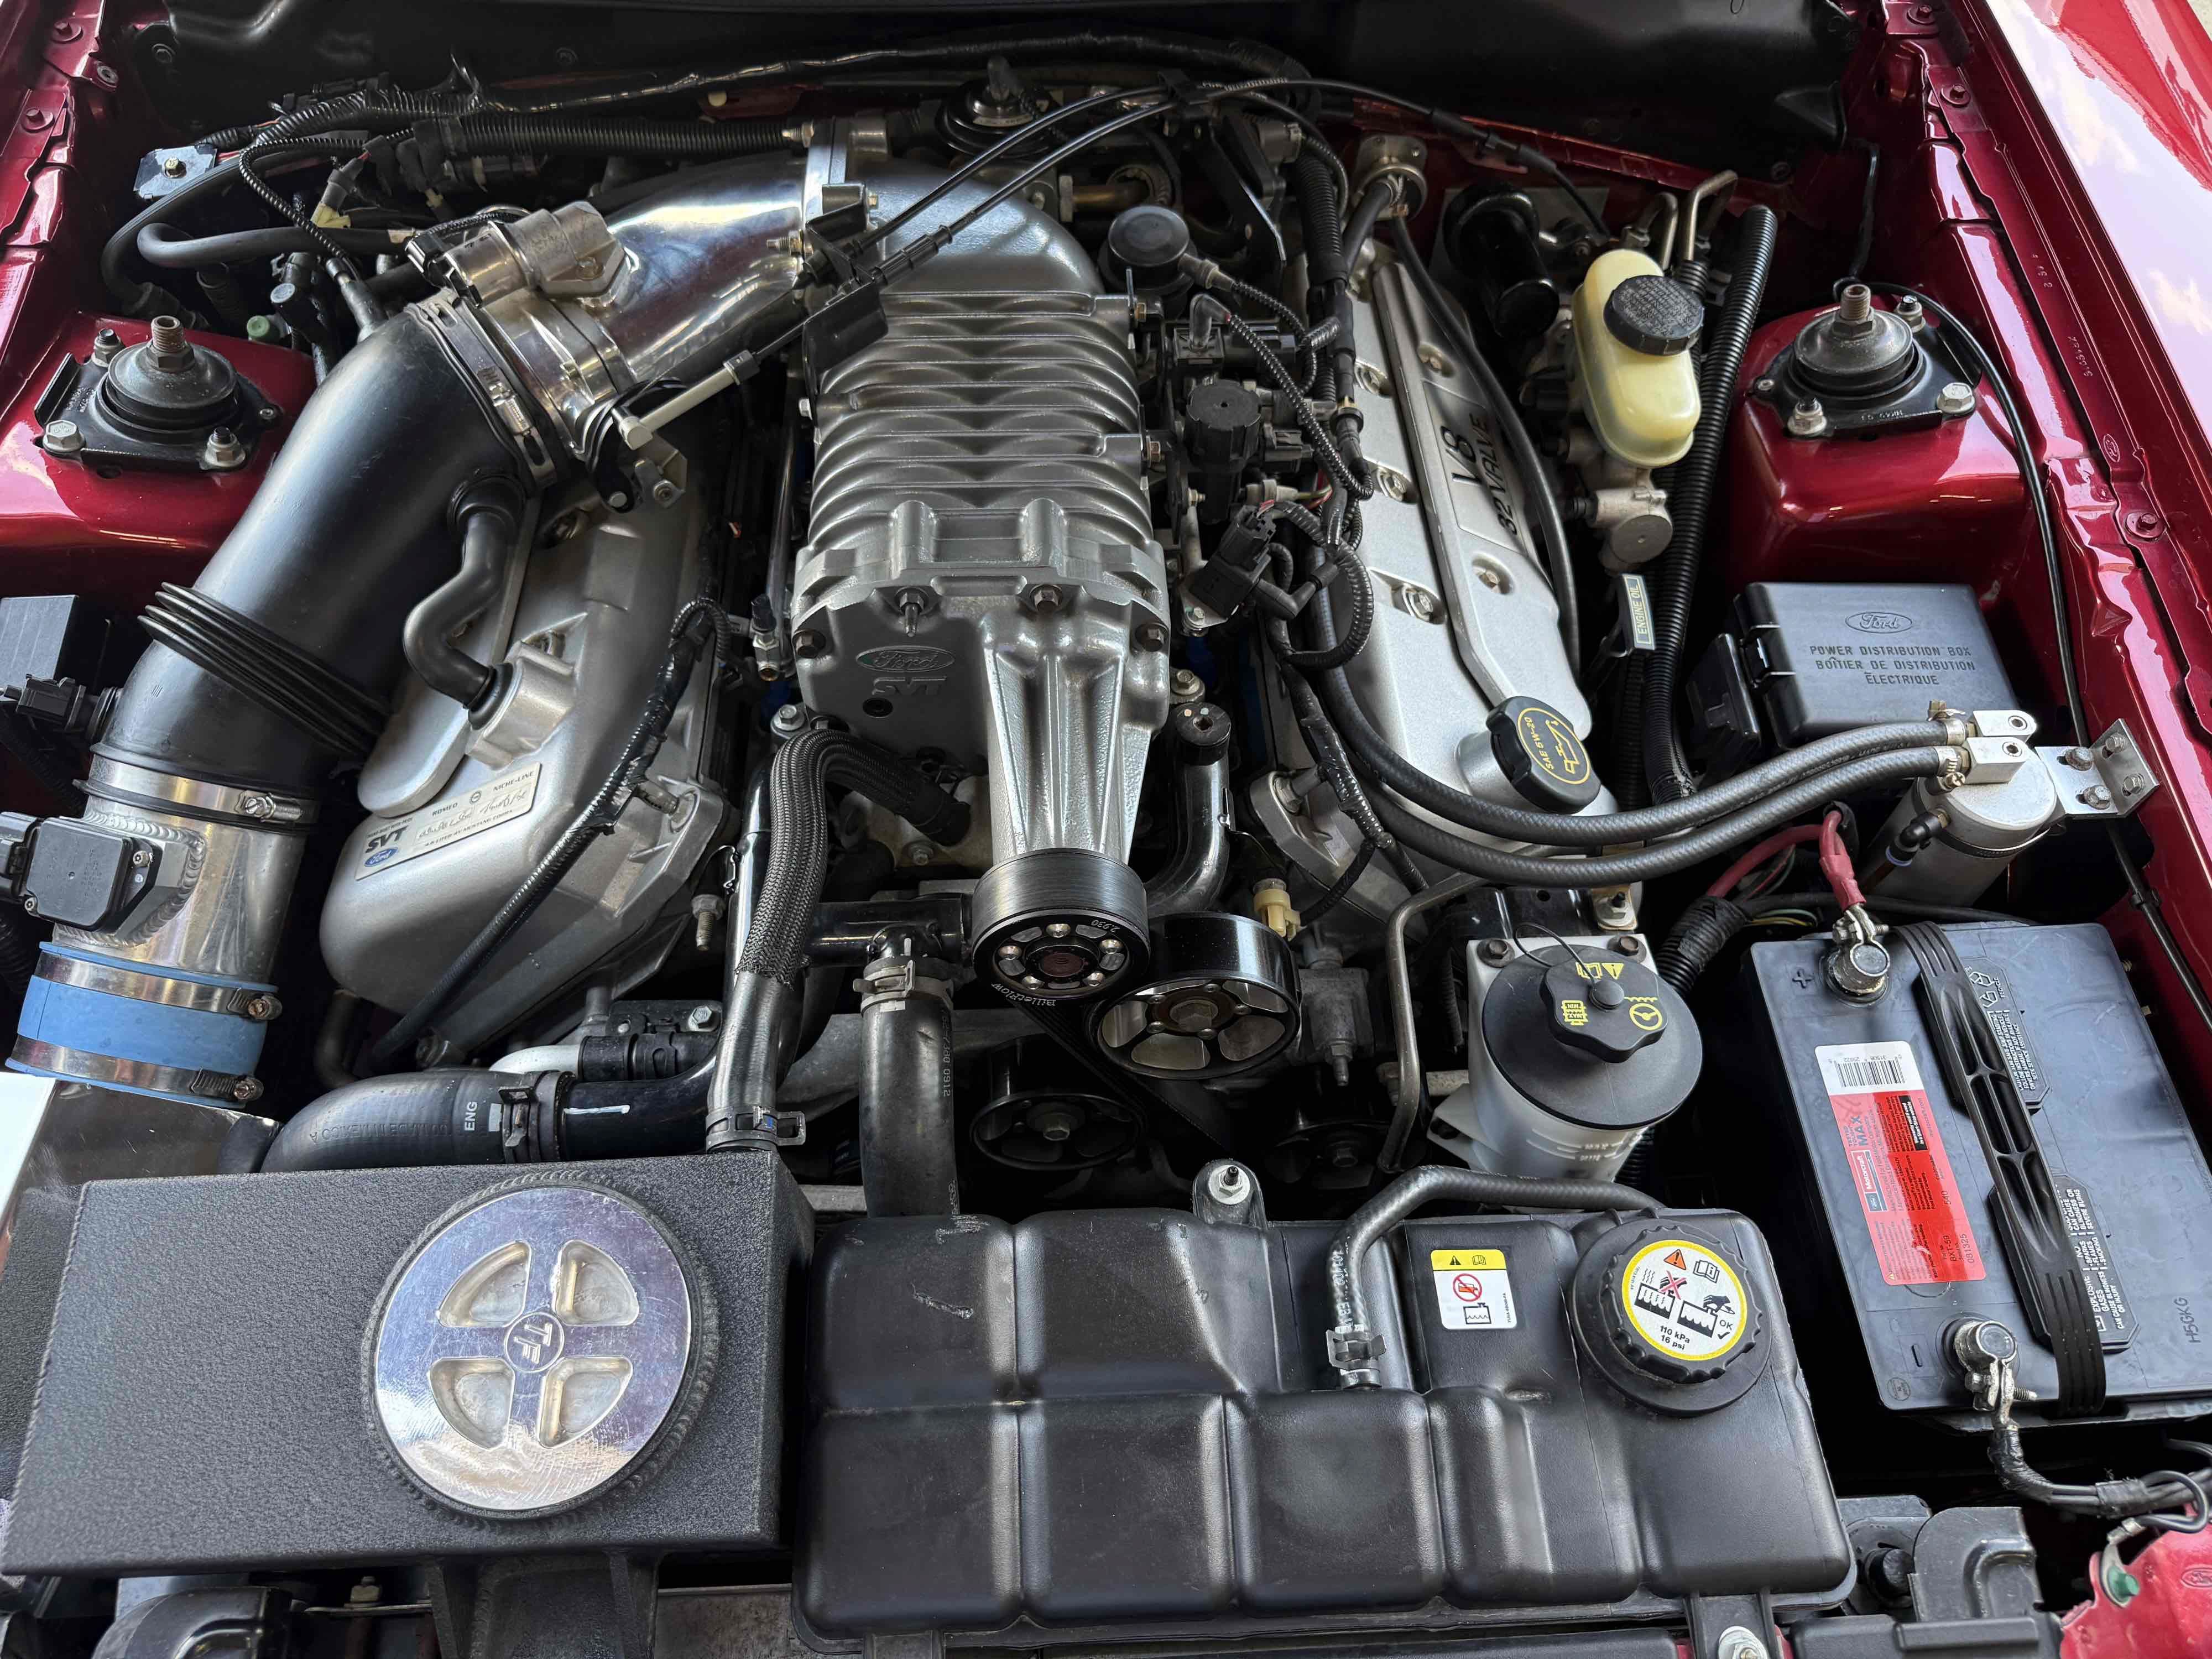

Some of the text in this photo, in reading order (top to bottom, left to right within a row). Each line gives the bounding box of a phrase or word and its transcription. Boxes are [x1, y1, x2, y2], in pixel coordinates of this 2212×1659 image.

[1441, 425, 1484, 486] V8
[1494, 497, 1517, 535] 32
[1629, 584, 1647, 634] ENGINE OIL
[1859, 613, 1900, 629] Ford
[874, 649, 939, 670] Ford
[1809, 645, 1972, 656] POWER DISTRIBUTION BOX
[1815, 656, 1976, 671] BOÎTIER DE DISTRIBUTION
[872, 675, 948, 696] SVT
[1524, 716, 1554, 771] SAE 5W-20
[365, 825, 409, 853] SVT
[1091, 919, 1121, 933] 2.930
[2006, 1039, 2022, 1070] INSTRUCTIONS
[943, 1068, 952, 1097] 0912
[463, 1100, 478, 1132] ENG
[1906, 1101, 1915, 1115] vehicle
[1850, 1115, 1869, 1146] MAX
[1908, 1124, 1919, 1143] Warranty
[1911, 1115, 1922, 1136] Start-Stop
[1856, 1155, 1872, 1189] Motorcraft
[1940, 1190, 1952, 1204] 540
[2063, 1198, 2073, 1217] CAUSE
[2071, 1199, 2086, 1229] BLINDNESS
[2073, 1189, 2094, 1229] SEVERE BURNS
[2072, 1219, 2080, 1229] CAN
[1942, 1234, 1958, 1261] BXT-59
[1959, 1233, 1975, 1264] 081325
[2074, 1246, 2083, 1257] NO
[2079, 1240, 2093, 1263] SPARKS
[2086, 1241, 2099, 1262] FLAMES
[2091, 1237, 2106, 1262] SMOKING
[2083, 1275, 2101, 1311] EXPLOSIVE
[2095, 1289, 2110, 1311] GASES
[2098, 1271, 2125, 1329] CAN CAUSE BLINDNESS
[2109, 1285, 2121, 1302] INJURY
[1660, 1325, 1691, 1344] 110 kPa
[1719, 1319, 1733, 1331] OK
[514, 1322, 553, 1365] TF
[1661, 1334, 1685, 1350] 16 psi
